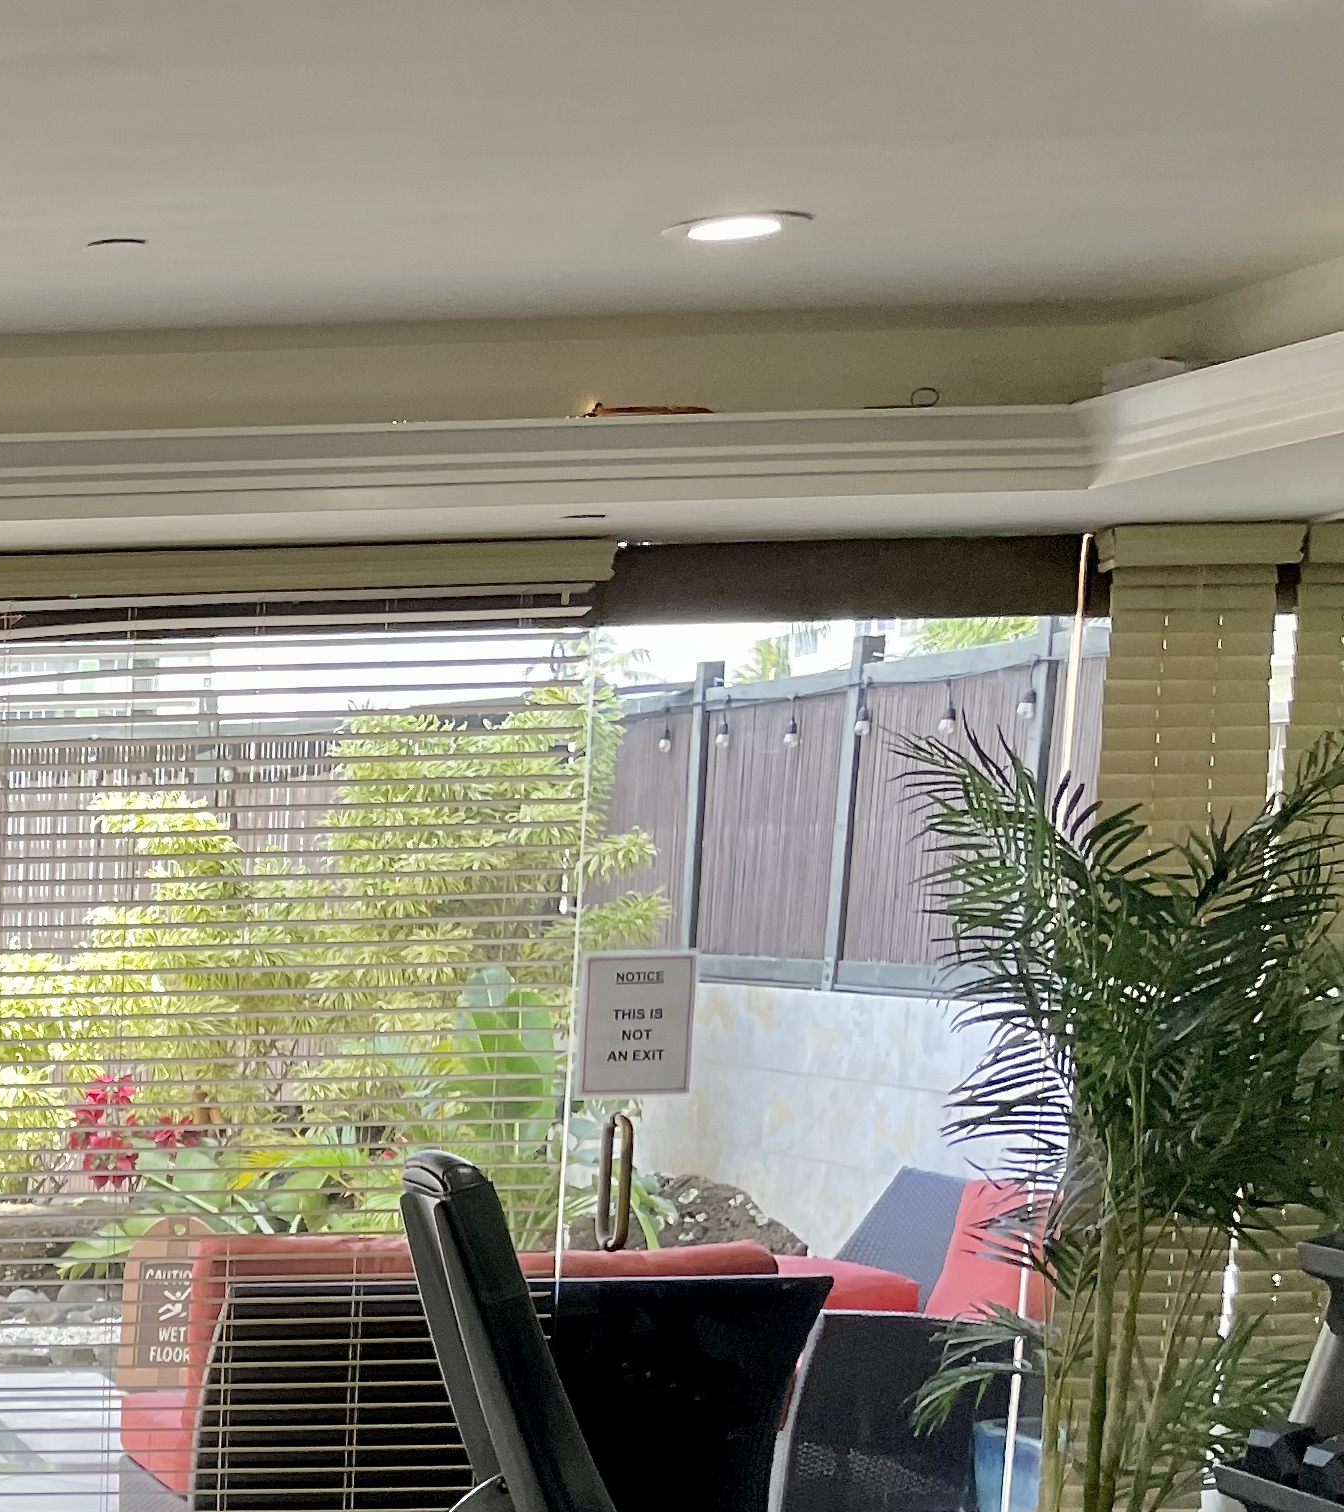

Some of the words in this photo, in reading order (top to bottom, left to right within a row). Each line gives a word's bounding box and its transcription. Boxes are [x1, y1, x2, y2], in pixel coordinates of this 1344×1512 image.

[615, 971, 665, 984] NOTICE
[614, 1008, 646, 1020] THIS
[649, 1008, 663, 1019] IS
[621, 1028, 654, 1041] NOT
[606, 1050, 628, 1062] AN
[632, 1049, 665, 1061] EXIT
[158, 1325, 187, 1343] WET
